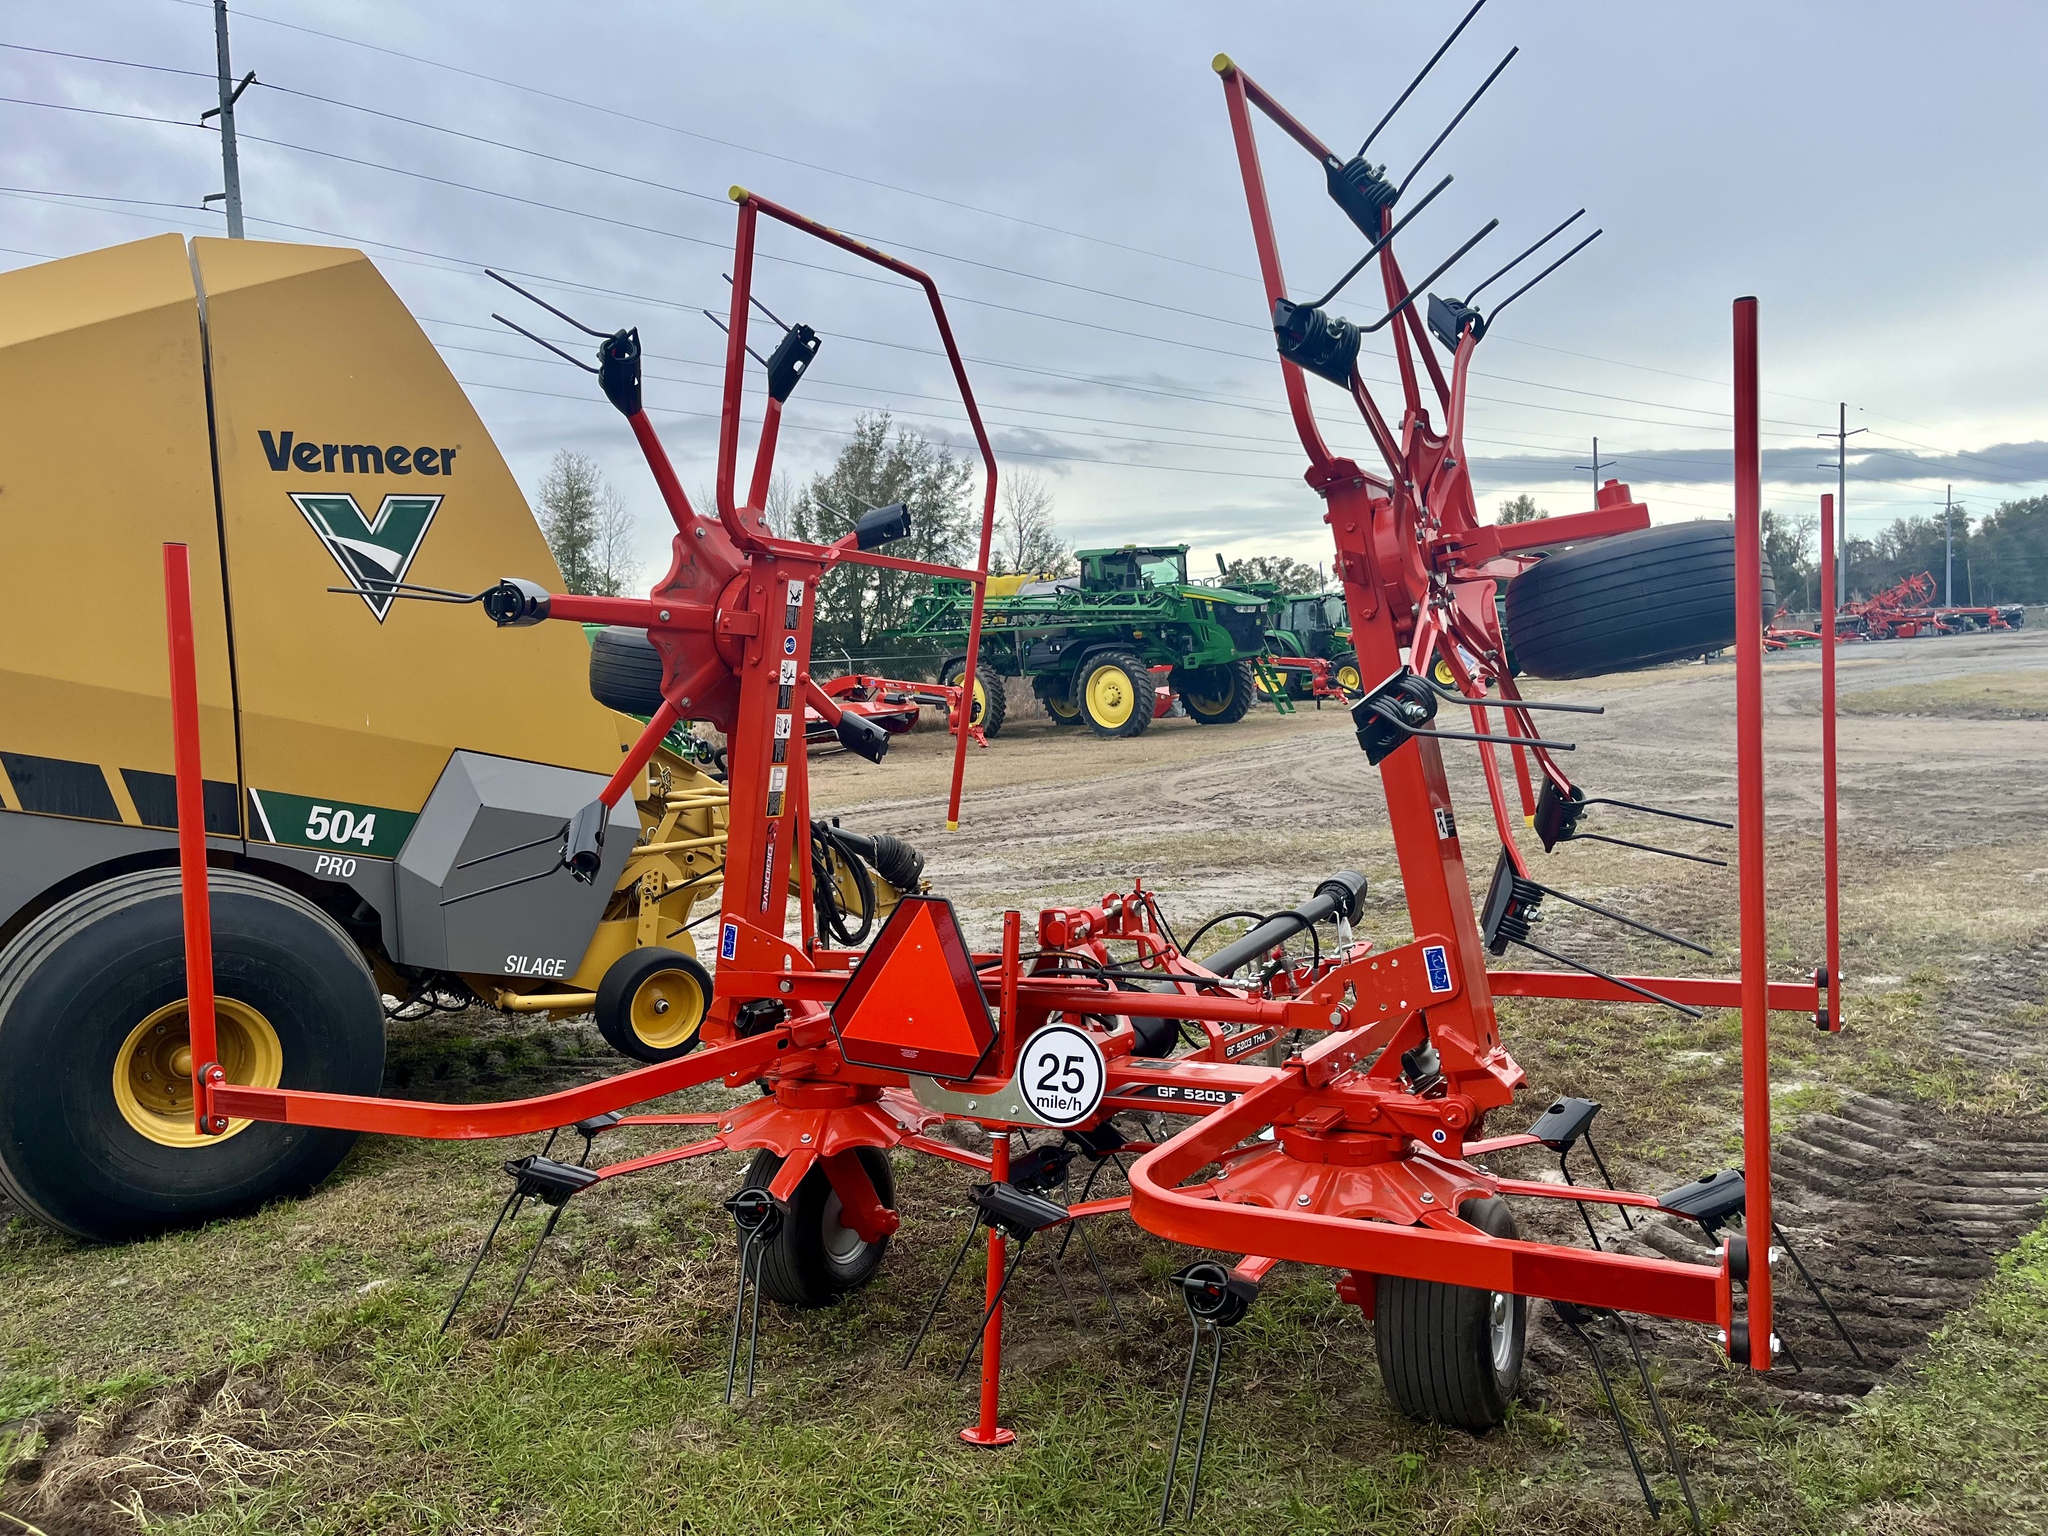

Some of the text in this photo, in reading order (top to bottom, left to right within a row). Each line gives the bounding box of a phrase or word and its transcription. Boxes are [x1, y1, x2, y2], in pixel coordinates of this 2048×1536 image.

[258, 430, 456, 476] Vermeer
[305, 805, 376, 847] 504
[314, 855, 357, 878] PRO
[761, 844, 774, 911] DIGIDRIVE
[504, 954, 567, 977] SILAGE
[1226, 1032, 1266, 1056] GF 5203 THA
[1036, 1053, 1085, 1095] 25
[1036, 1095, 1082, 1111] mile/h
[1157, 1086, 1179, 1098] GF
[1184, 1089, 1227, 1102] 5203
